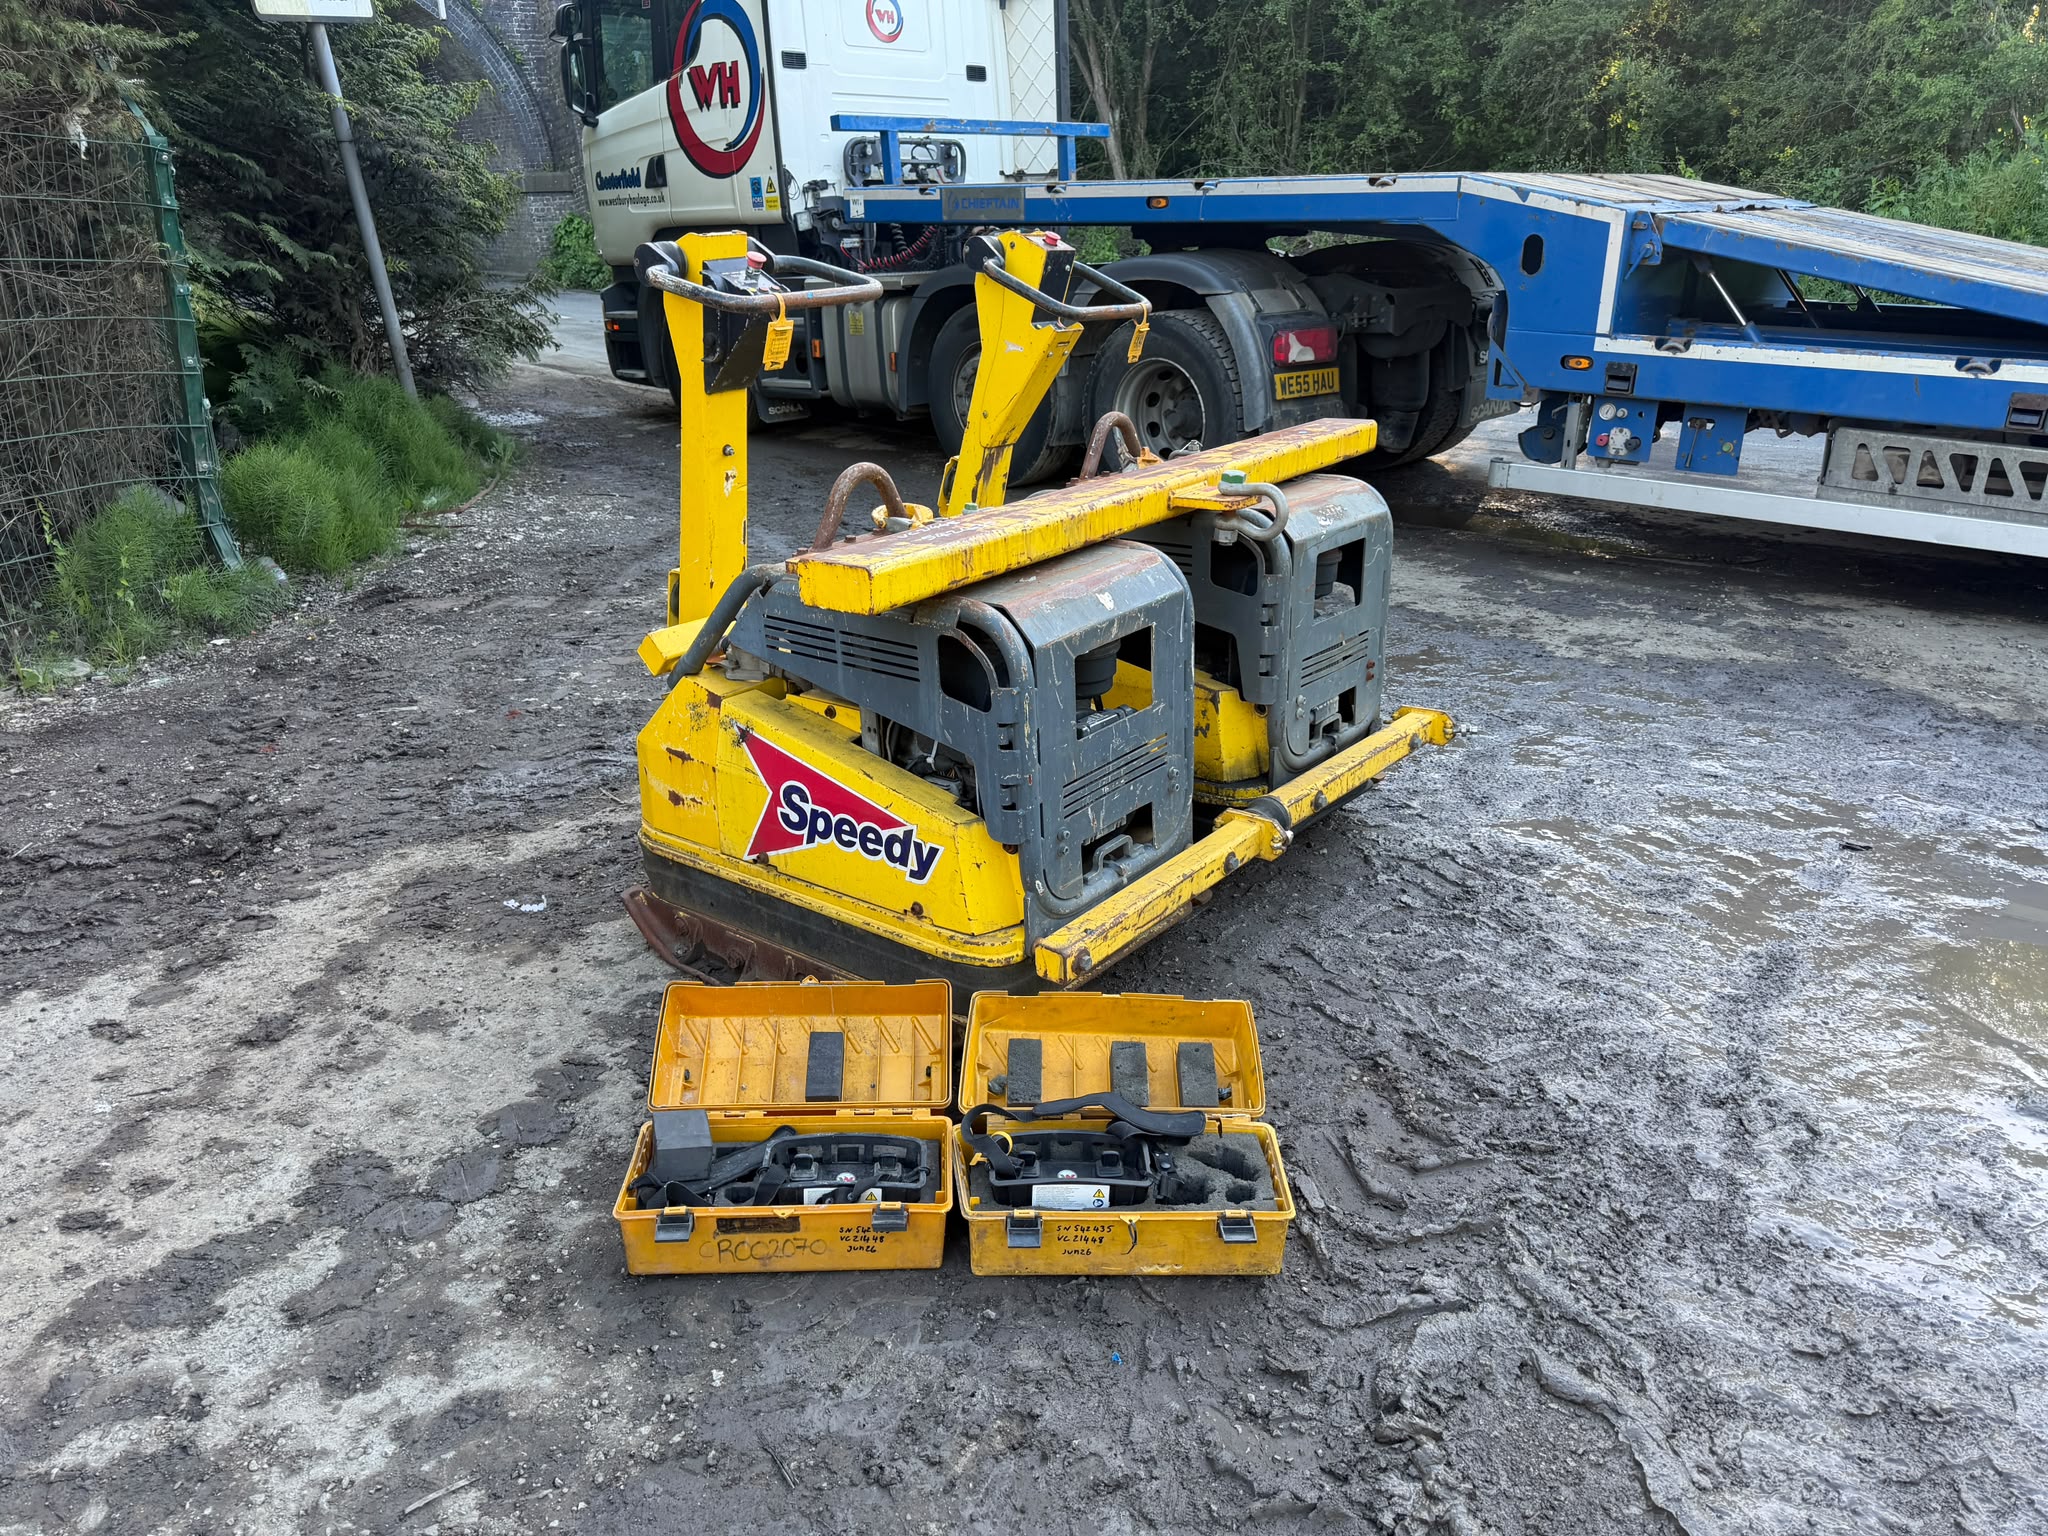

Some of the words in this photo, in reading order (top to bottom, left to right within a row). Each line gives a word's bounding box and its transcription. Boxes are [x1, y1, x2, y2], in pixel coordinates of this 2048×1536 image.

[875, 9, 895, 24] WH
[687, 60, 741, 112] WH
[596, 166, 641, 191] Chesterfield
[598, 191, 666, 207] www.westburyhaulage.co.uk
[961, 198, 1019, 210] CHIEFTAIN
[1279, 374, 1310, 397] WE55
[1313, 371, 1335, 394] HAU
[1470, 400, 1511, 421] SCANIA
[779, 783, 941, 882] Speedy
[839, 1226, 853, 1234] SN
[1056, 1225, 1072, 1233] SN
[1074, 1224, 1115, 1234] 542435
